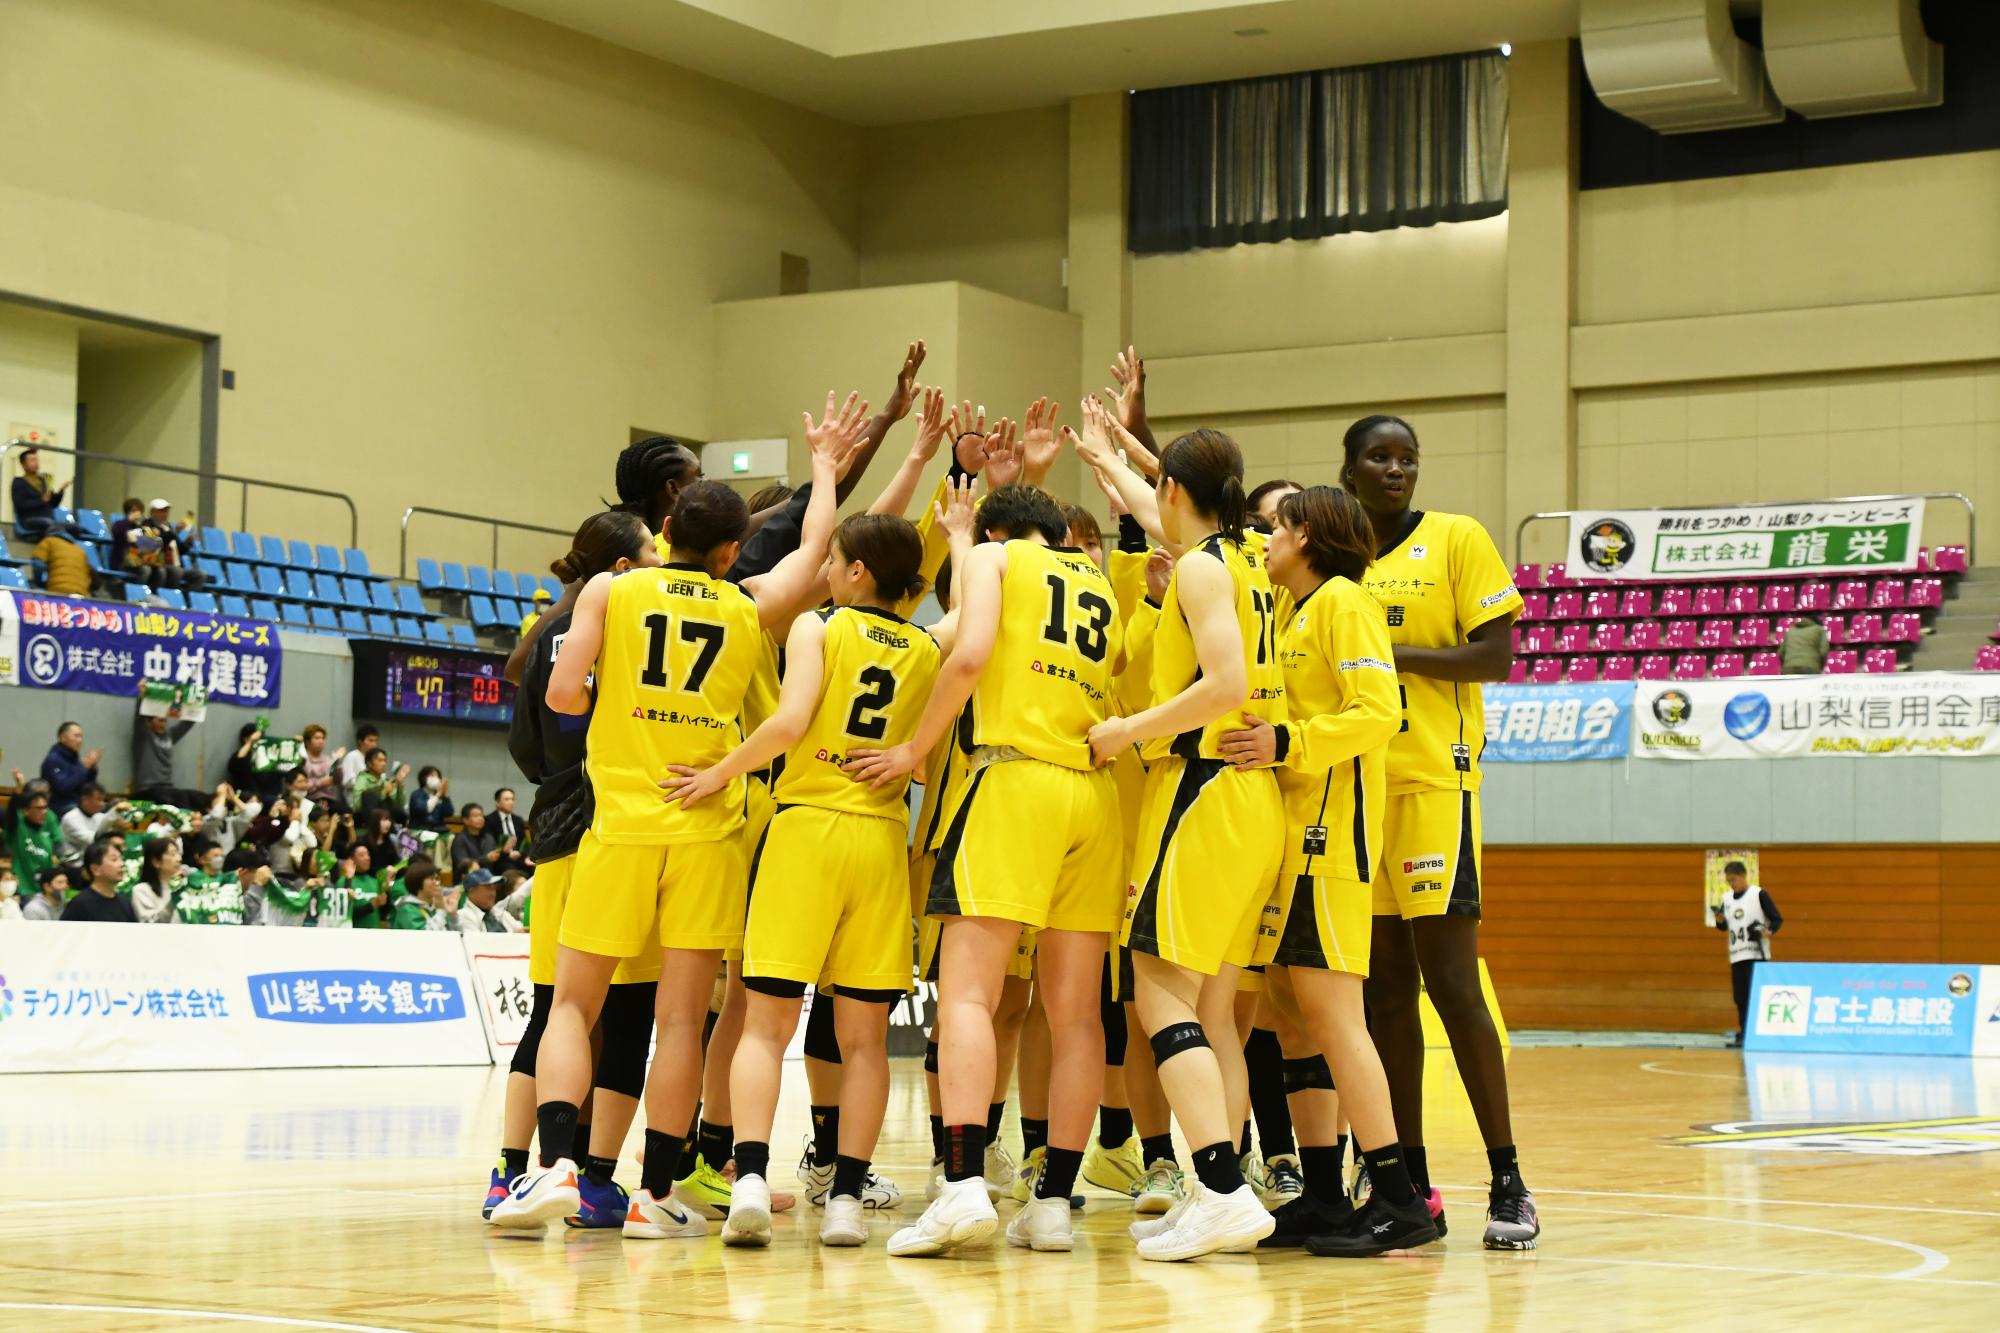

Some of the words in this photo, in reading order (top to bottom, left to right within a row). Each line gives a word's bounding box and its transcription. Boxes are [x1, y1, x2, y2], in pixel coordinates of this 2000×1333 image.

[1665, 541, 1763, 564] 株式会社
[1360, 578, 1436, 590] ヤマクッキー
[1044, 574, 1112, 662] 13
[641, 613, 724, 692] 17
[66, 645, 135, 678] 株式会社
[143, 643, 269, 698] 中村建設
[416, 677, 444, 710] 47
[846, 666, 895, 739] 2
[1780, 694, 2000, 731] 山梨信用金庫
[324, 887, 349, 920] 30
[23, 988, 230, 1018] テクノクリーン株式会社
[261, 979, 452, 1015] 山梨中央銀行
[1813, 995, 1955, 1025] 富士島建設
